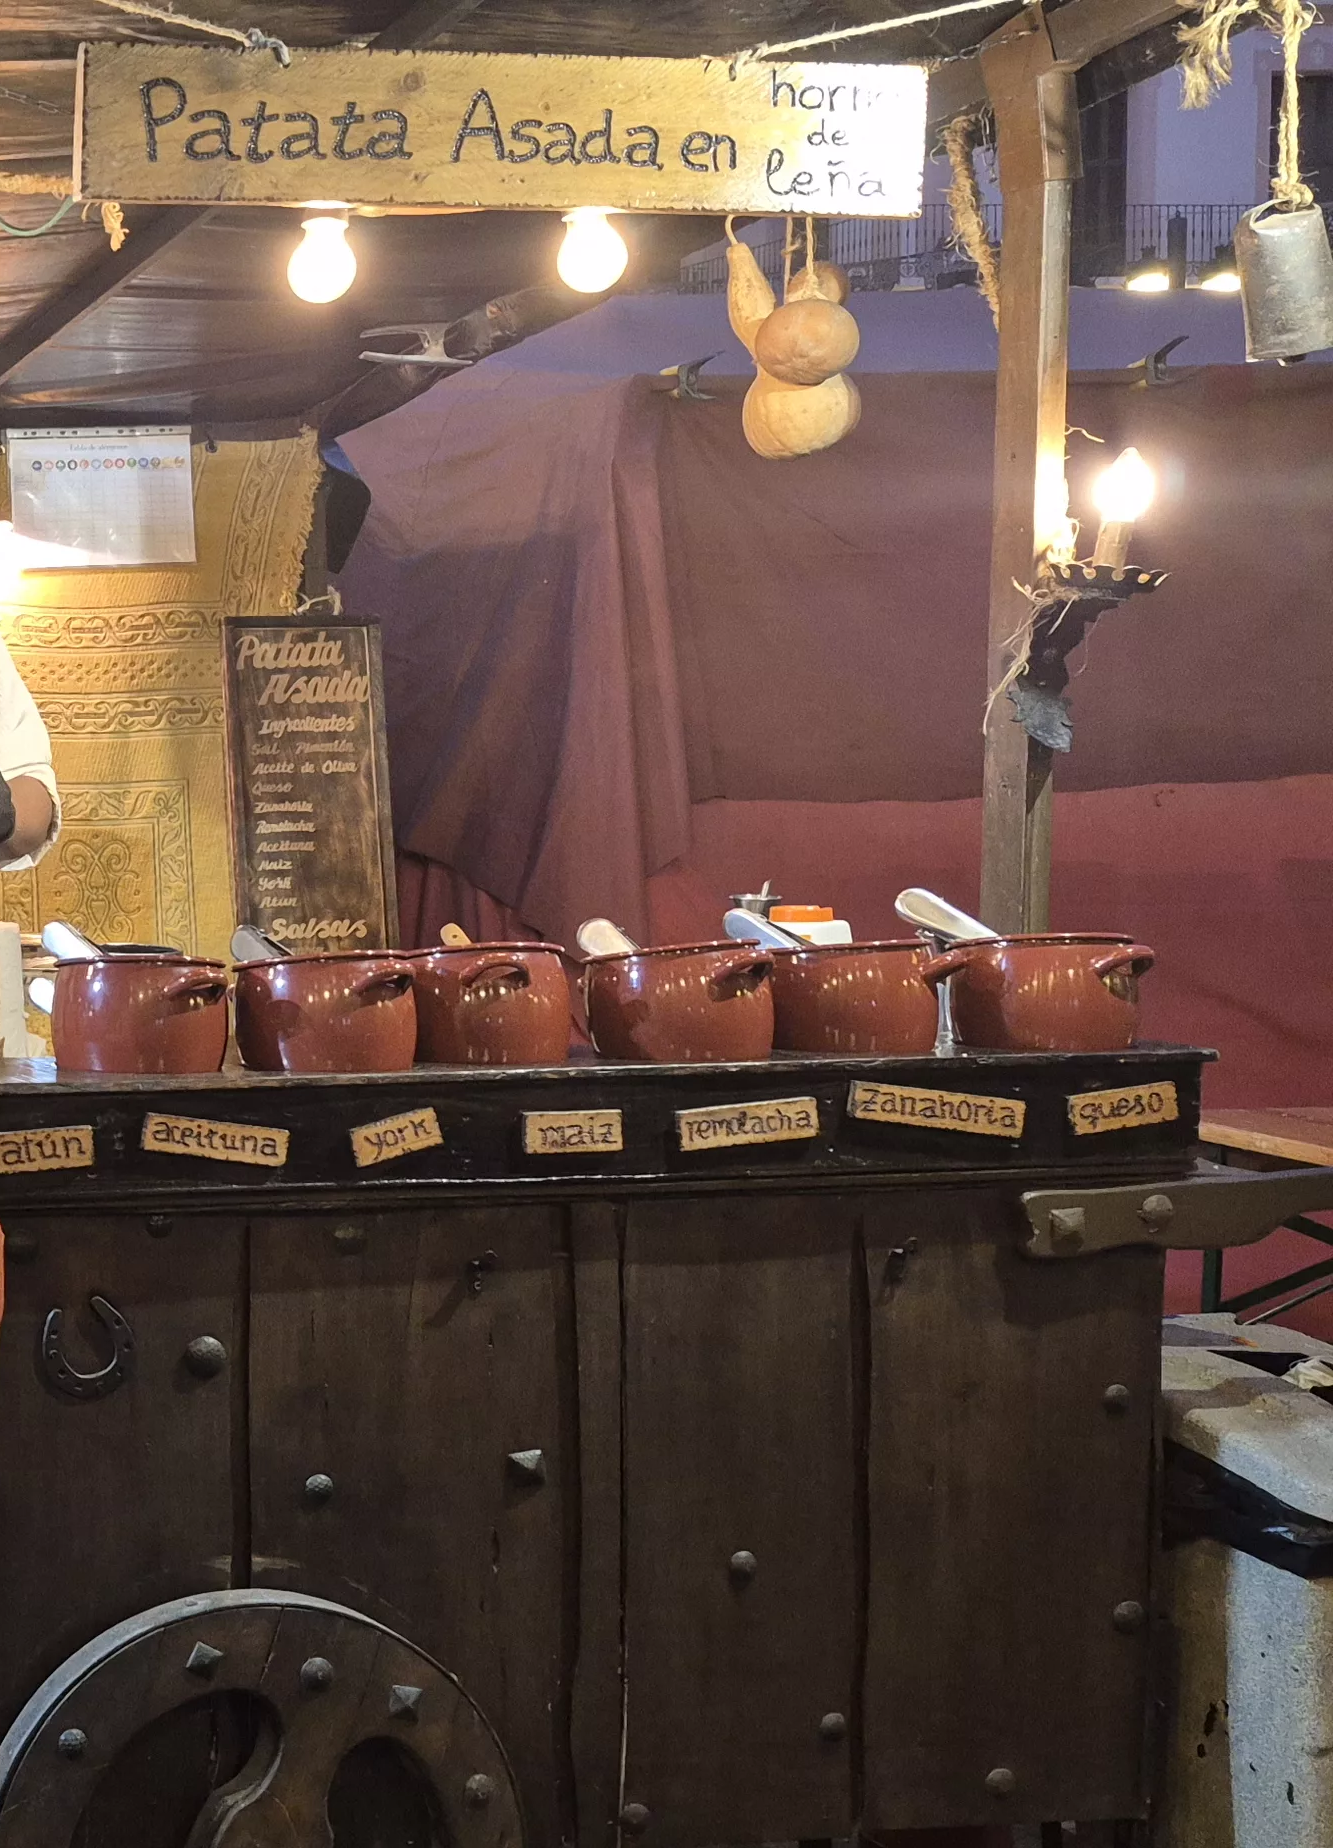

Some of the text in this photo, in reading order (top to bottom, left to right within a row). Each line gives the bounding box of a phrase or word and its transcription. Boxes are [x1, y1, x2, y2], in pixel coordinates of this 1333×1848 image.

[138, 77, 737, 173] Patata Asada en
[806, 118, 850, 147] de
[235, 631, 345, 670] Patata
[258, 670, 370, 706] Asada
[258, 714, 356, 738] Ingredientes
[252, 760, 358, 775] Aceite de Oliva
[252, 781, 293, 796] Queso
[253, 801, 313, 814] Zanahoria
[255, 820, 316, 834] Remolacha
[256, 840, 315, 854] Aceituna
[258, 876, 292, 891] York
[269, 918, 368, 941] Salsas
[1079, 1091, 1165, 1130] queso
[152, 1119, 279, 1158] aceituna
[364, 1117, 432, 1160] york
[684, 1108, 813, 1143] remolacha
[1, 1133, 87, 1166] atún
